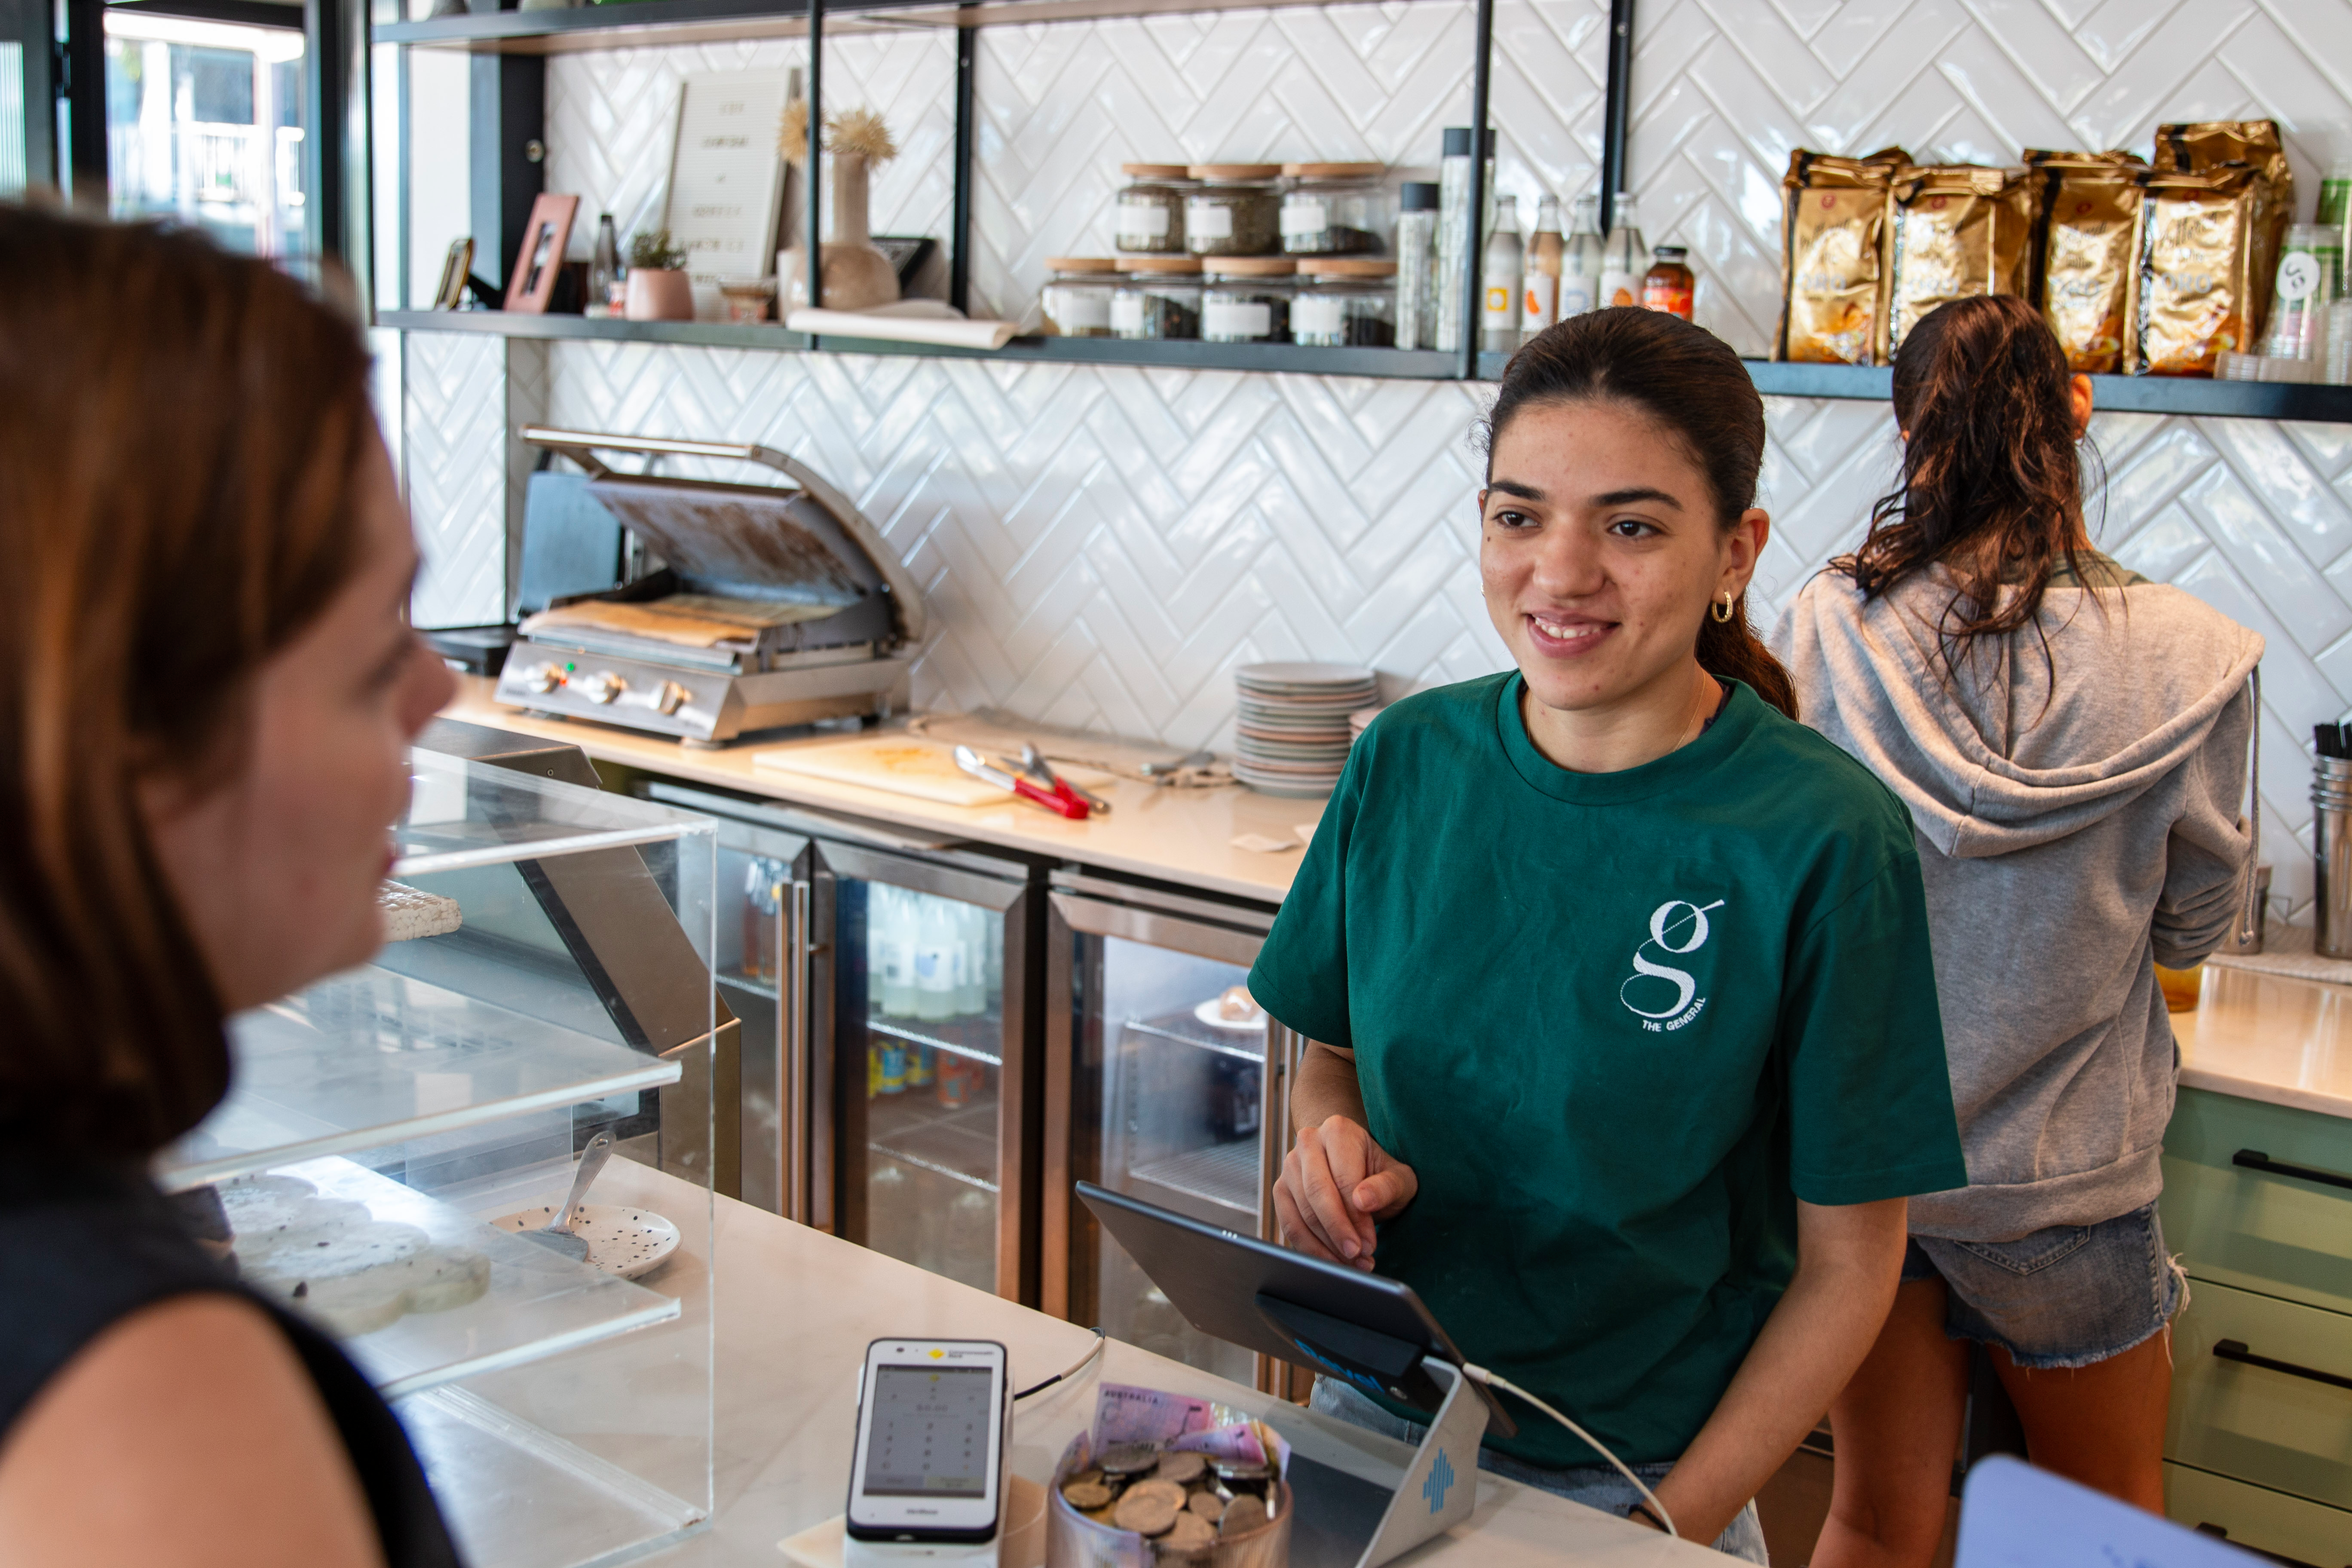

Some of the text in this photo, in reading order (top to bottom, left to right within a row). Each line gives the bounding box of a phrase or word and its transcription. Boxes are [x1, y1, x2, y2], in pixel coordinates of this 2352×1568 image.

[2162, 272, 2213, 294] ORO
[1642, 997, 1706, 1032] THE GENERAL
